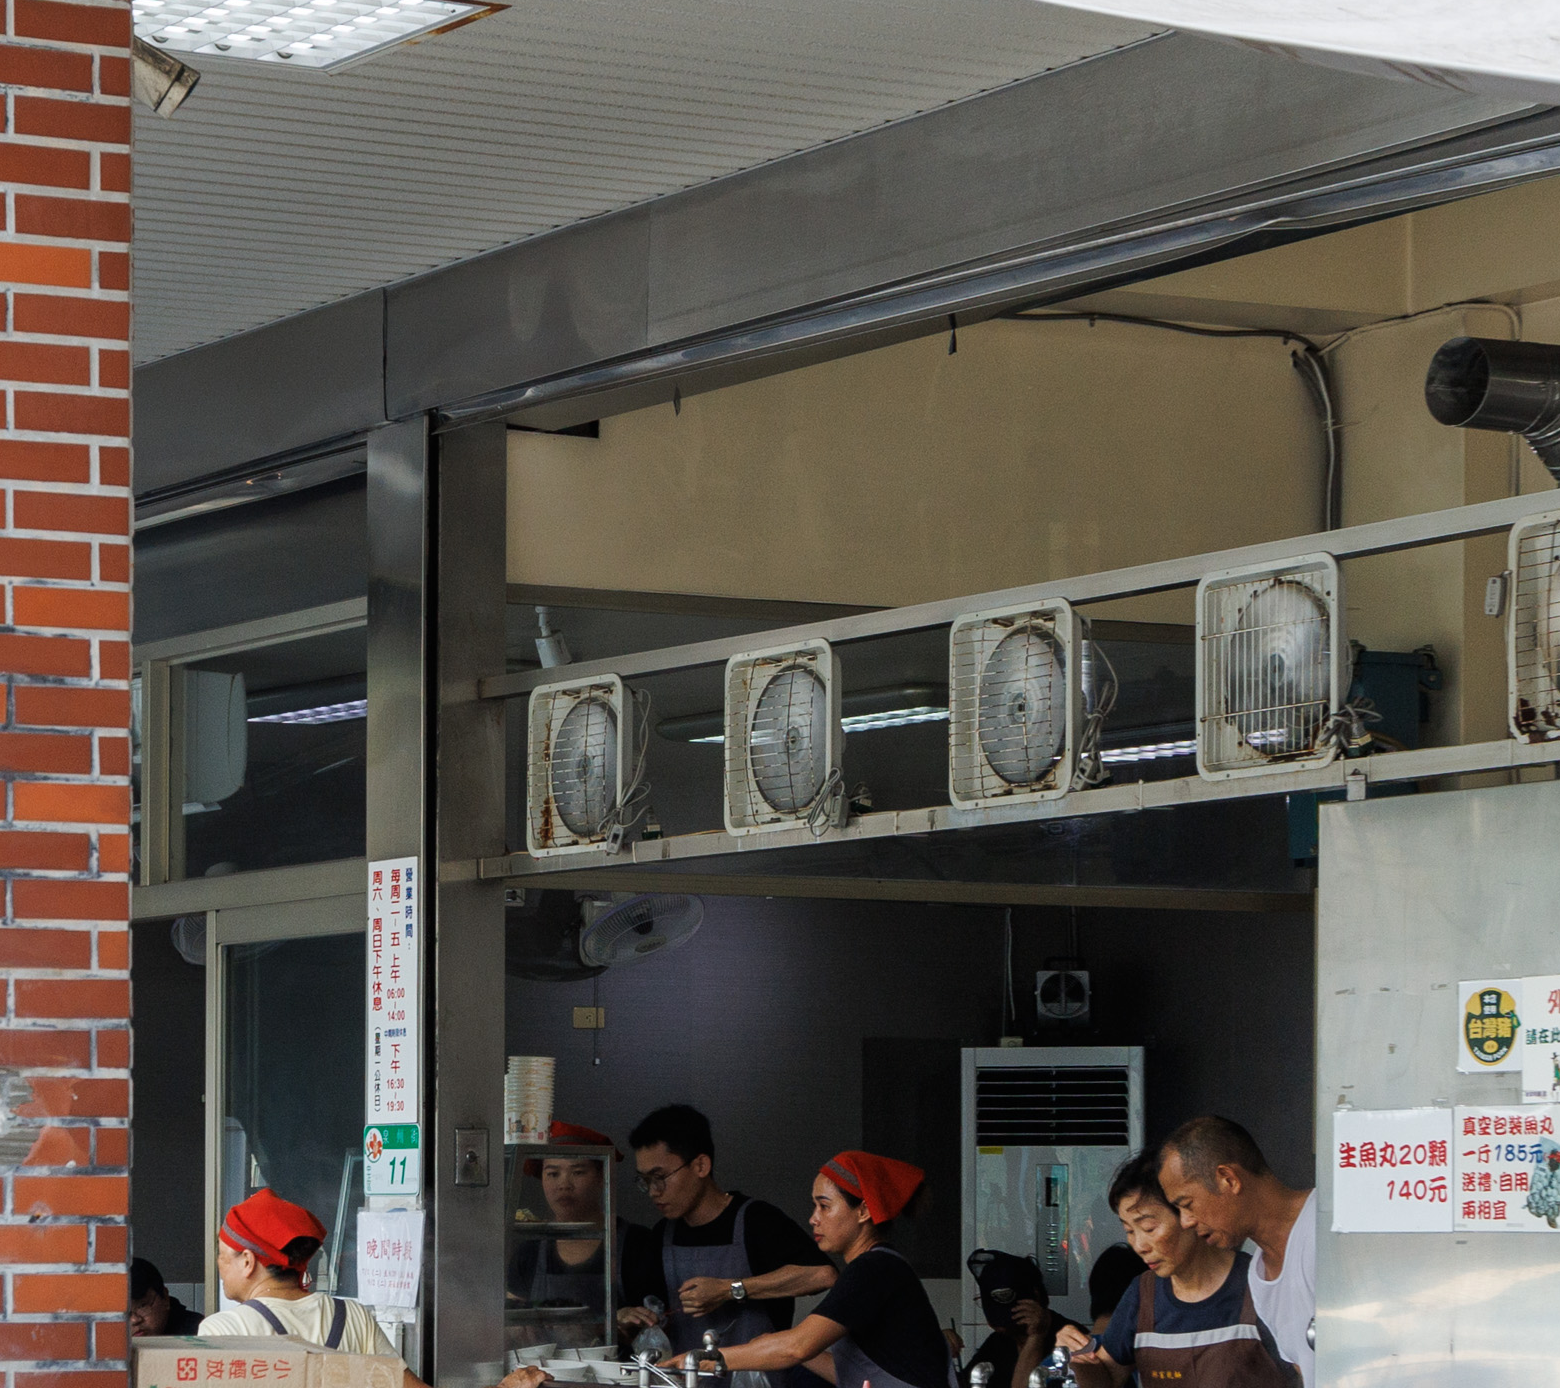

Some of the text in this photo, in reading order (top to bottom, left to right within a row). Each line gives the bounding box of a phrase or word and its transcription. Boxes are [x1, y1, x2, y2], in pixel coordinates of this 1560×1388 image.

[390, 953, 401, 984] 上午
[386, 988, 405, 1000] 06:00
[387, 1010, 406, 1021] 14:00
[390, 1043, 401, 1074] 下午
[386, 1078, 405, 1090] 16:30
[386, 1100, 405, 1112] 19:30
[1462, 1115, 1555, 1136] 真空包裝魚丸
[1338, 1139, 1448, 1168] 生魚丸20顆
[1462, 1143, 1544, 1164] 一斤185元
[389, 1156, 407, 1185] 11
[1386, 1175, 1448, 1203] 140元
[1461, 1200, 1507, 1220] 兩相宜
[366, 1238, 413, 1261] 晚間時段
[205, 1358, 292, 1380] 小心輕放
